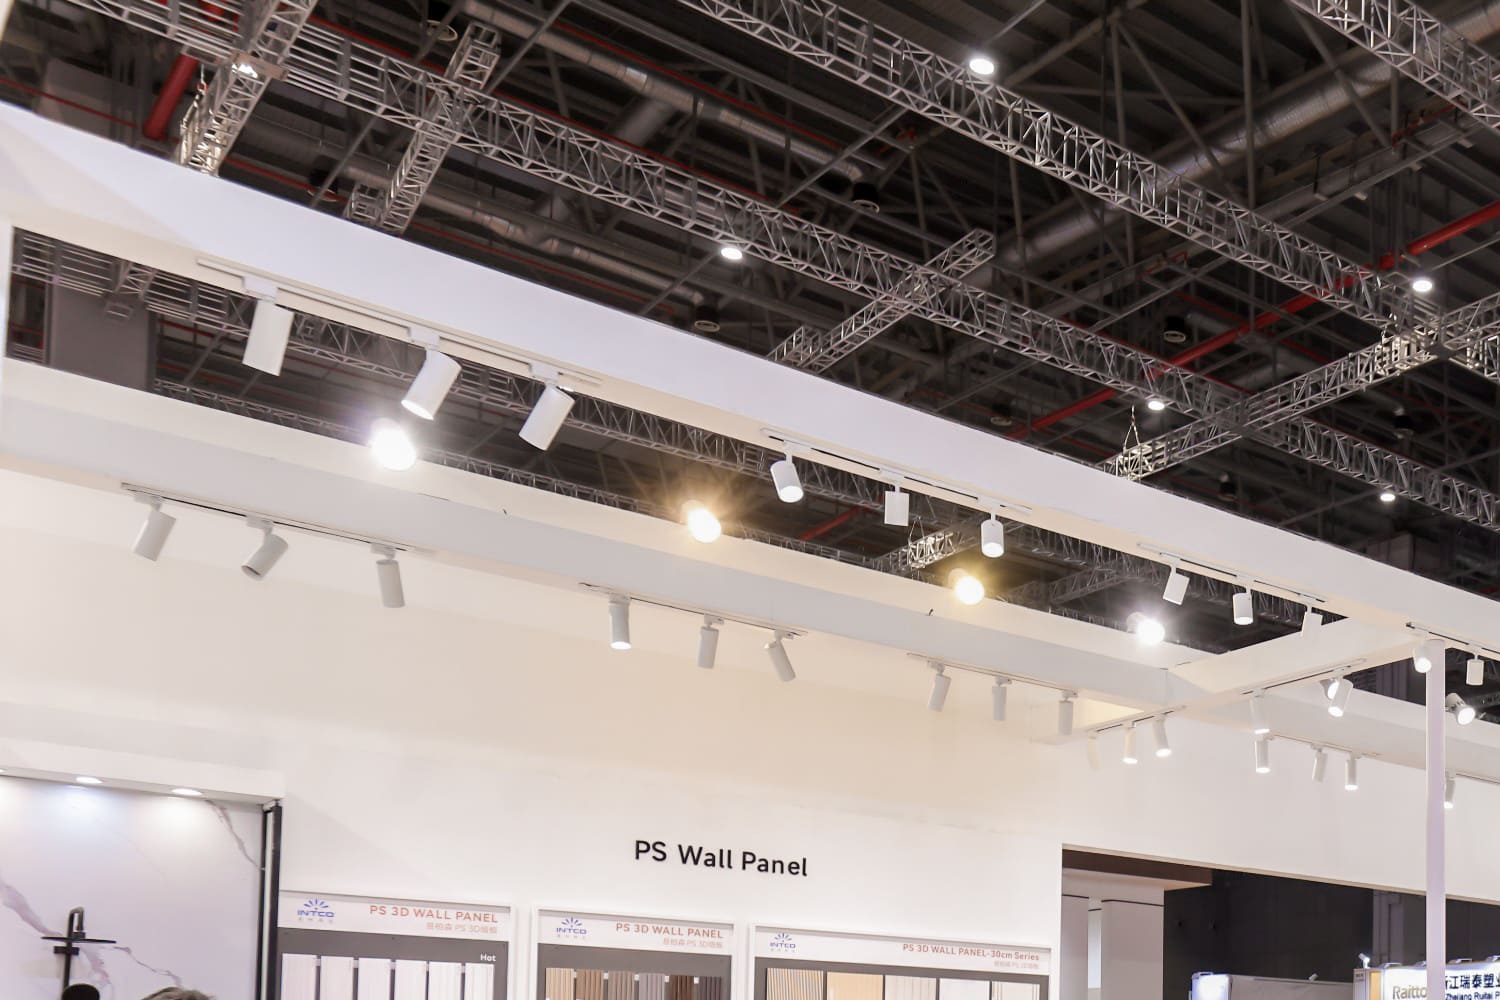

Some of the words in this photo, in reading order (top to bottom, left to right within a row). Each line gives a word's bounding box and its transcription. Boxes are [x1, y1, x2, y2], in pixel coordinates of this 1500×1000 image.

[634, 839, 668, 862] PS
[677, 843, 733, 870] Wall
[741, 850, 808, 877] Panel
[369, 904, 387, 916] PS
[391, 906, 410, 917] 3D
[412, 908, 452, 920] WALL
[455, 911, 499, 923] PANEL
[615, 922, 631, 933] PS
[633, 924, 649, 934] 3D
[651, 925, 684, 937] WALL
[687, 928, 724, 939] PANEL
[479, 953, 497, 963] Hot
[902, 943, 915, 953] PS
[918, 944, 930, 954] 3D
[931, 945, 957, 955] WALL
[1014, 951, 1040, 962] Series
